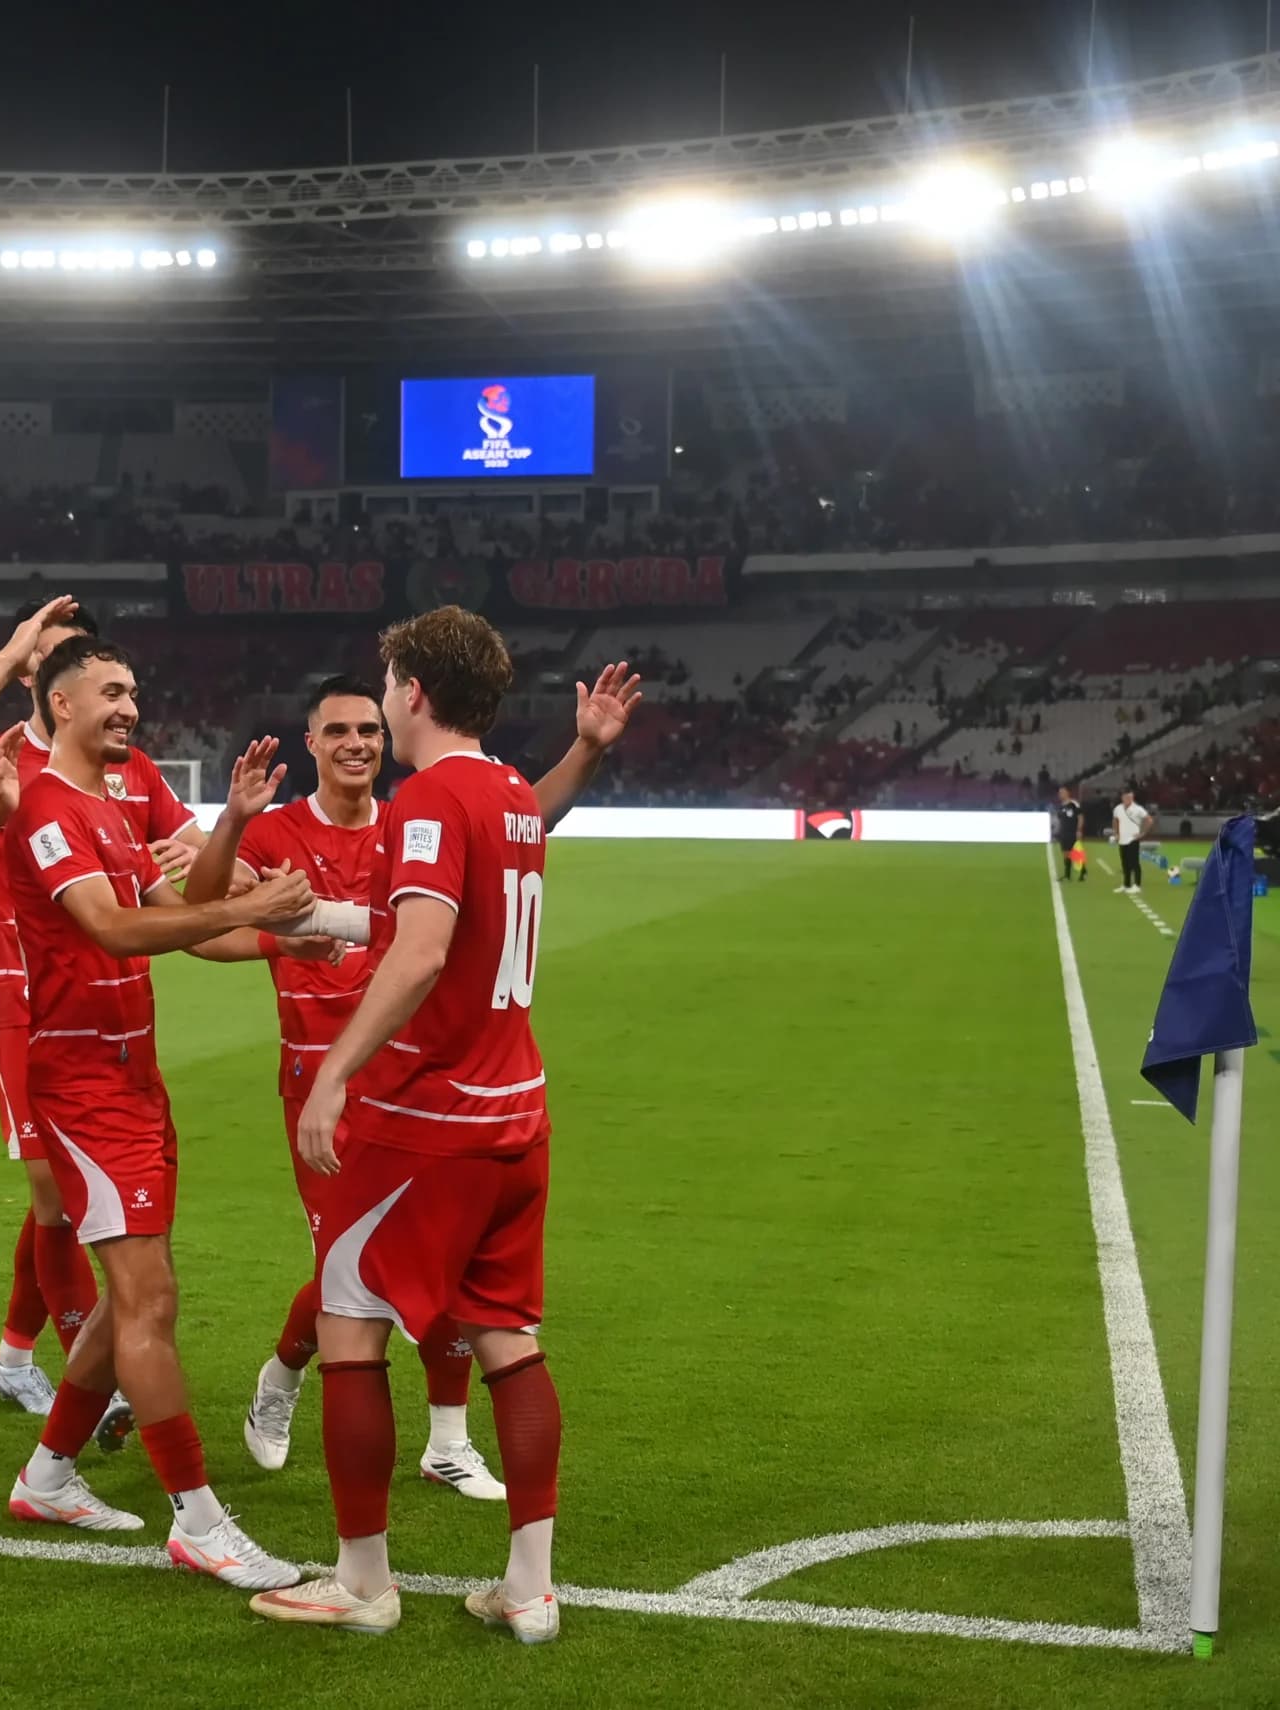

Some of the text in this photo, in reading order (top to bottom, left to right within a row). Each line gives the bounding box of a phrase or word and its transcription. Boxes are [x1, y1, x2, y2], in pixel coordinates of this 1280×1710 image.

[462, 448, 532, 460] ASEAN CUP
[482, 439, 511, 450] FIFA
[183, 558, 726, 614] ULTRAS GARUDA
[491, 868, 544, 1010] 10
